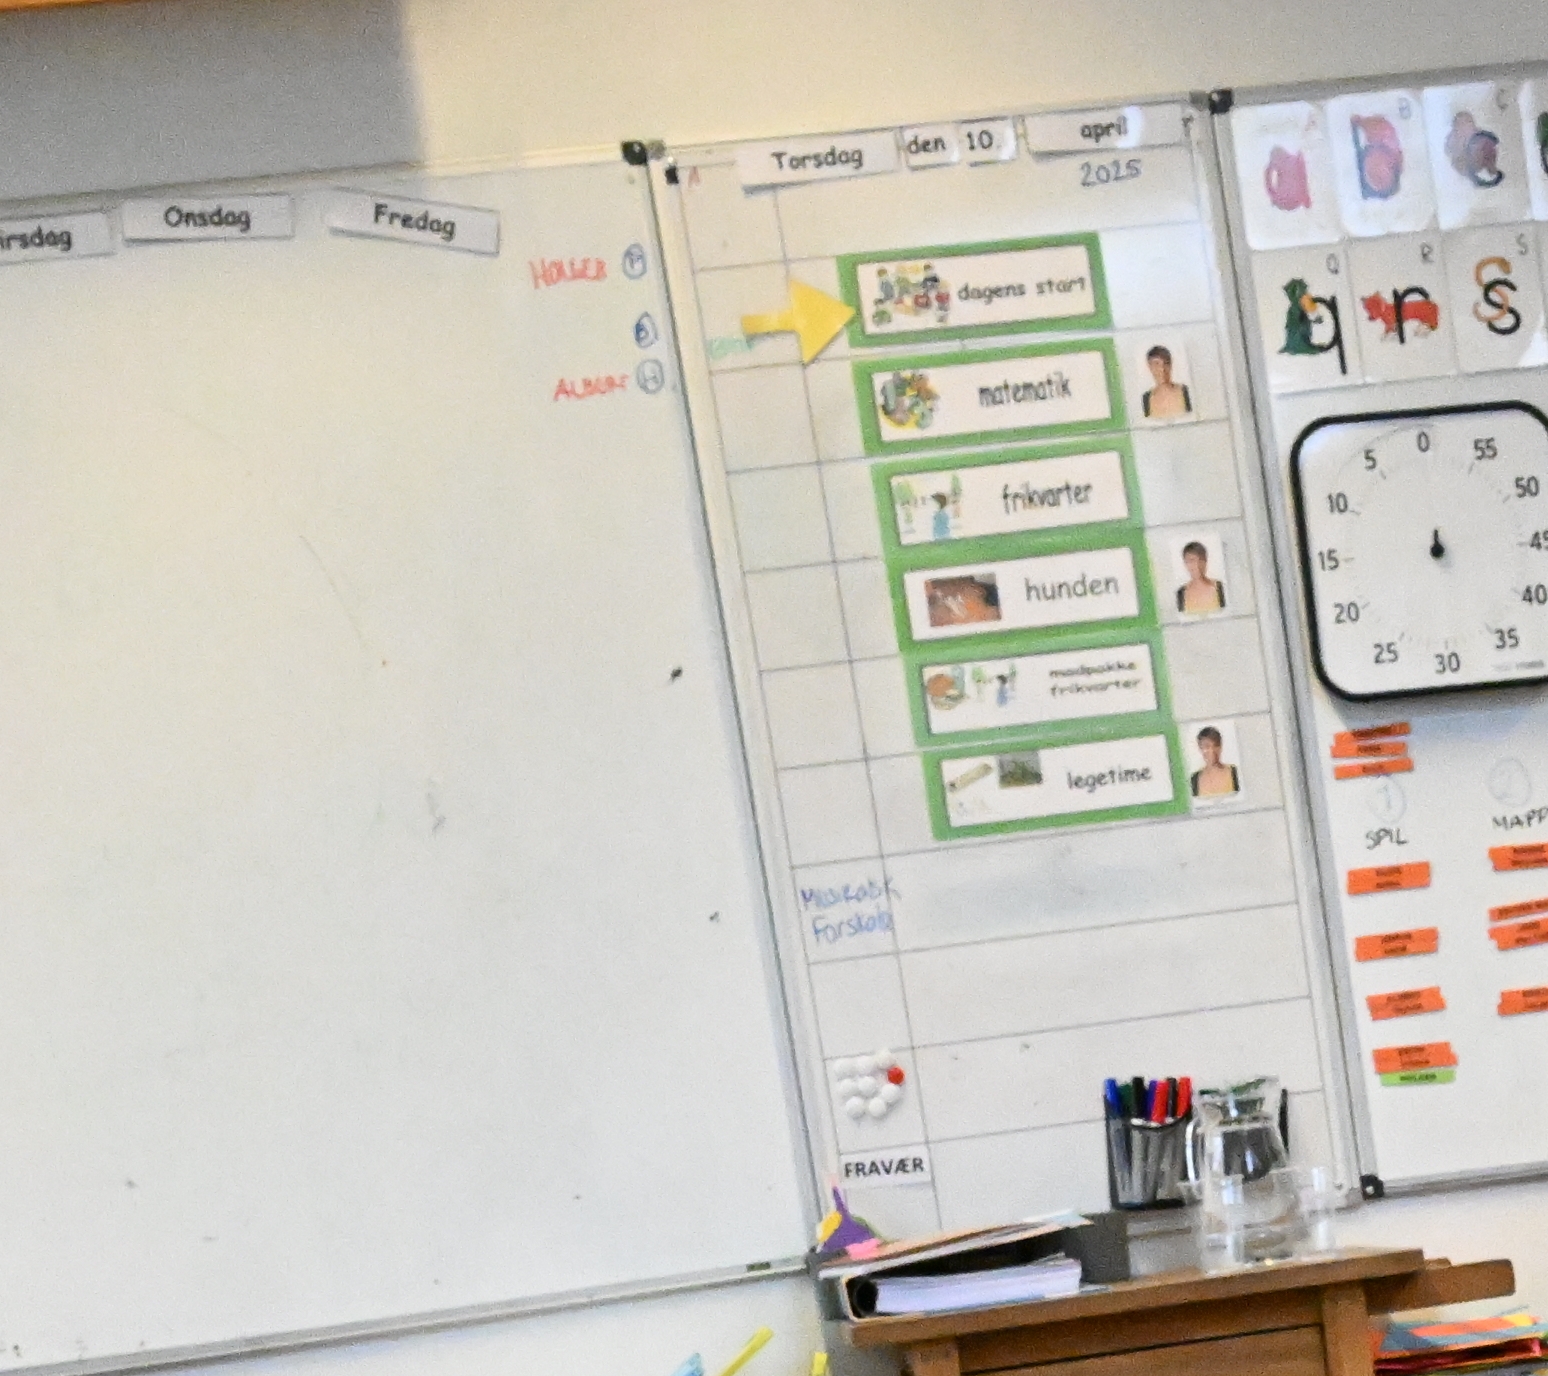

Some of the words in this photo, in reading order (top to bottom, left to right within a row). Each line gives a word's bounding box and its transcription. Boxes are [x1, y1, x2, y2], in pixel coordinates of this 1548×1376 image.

[770, 146, 865, 172] Torsdag
[905, 133, 947, 156] den
[965, 129, 995, 152] 10
[1079, 114, 1128, 144] april
[1079, 157, 1143, 188] 2025
[1467, 129, 1505, 189] c
[163, 203, 252, 233] Onsdag
[373, 203, 457, 242] Fredag
[1420, 242, 1435, 264] R
[1515, 232, 1529, 255] S
[956, 272, 1028, 306] dagens
[1035, 271, 1087, 295] start
[1304, 294, 1348, 375] q
[1392, 286, 1431, 345] r
[1482, 277, 1522, 336] s
[978, 370, 1073, 409] matematik
[1416, 430, 1432, 455] 0
[1473, 436, 1498, 461] 55
[1363, 449, 1378, 471] 5
[1001, 480, 1094, 516] frikvarter
[1514, 475, 1541, 499] 50
[1327, 491, 1349, 514] 10
[1317, 549, 1341, 572] 15
[1024, 572, 1121, 602] hunden
[1521, 583, 1548, 606] 40
[1333, 601, 1361, 625] 20
[1493, 627, 1521, 650] 35
[1372, 641, 1400, 666] 25
[1434, 650, 1462, 674] 30
[1066, 762, 1154, 794] legetime
[1364, 826, 1409, 851] SPIL
[843, 1155, 925, 1182] FRAVÆR
